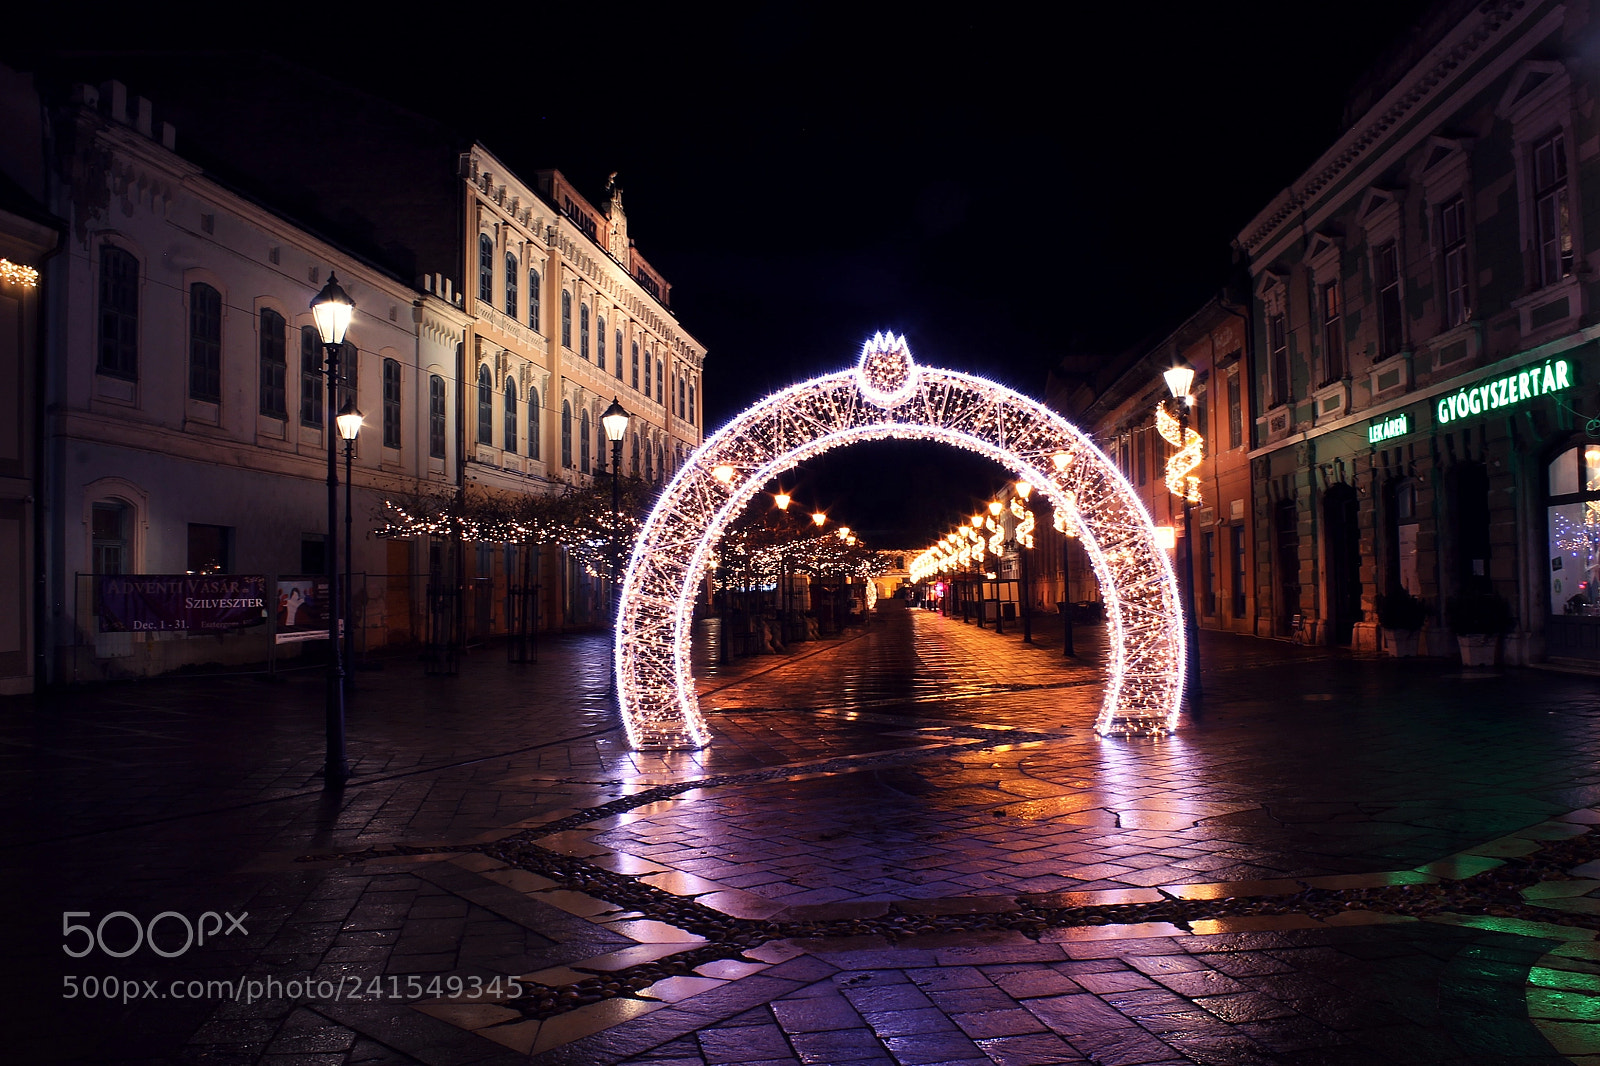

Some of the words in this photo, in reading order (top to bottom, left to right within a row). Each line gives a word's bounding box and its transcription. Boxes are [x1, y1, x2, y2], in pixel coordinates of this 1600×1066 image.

[1438, 359, 1571, 424] GYÓGYSZERTÁR
[107, 579, 184, 594] ADVENTI
[186, 578, 240, 594] VÁSÁR
[185, 597, 264, 609] SZILVESZTER
[133, 620, 157, 630] Dec.
[160, 620, 165, 630] 1
[174, 619, 190, 630] 31.
